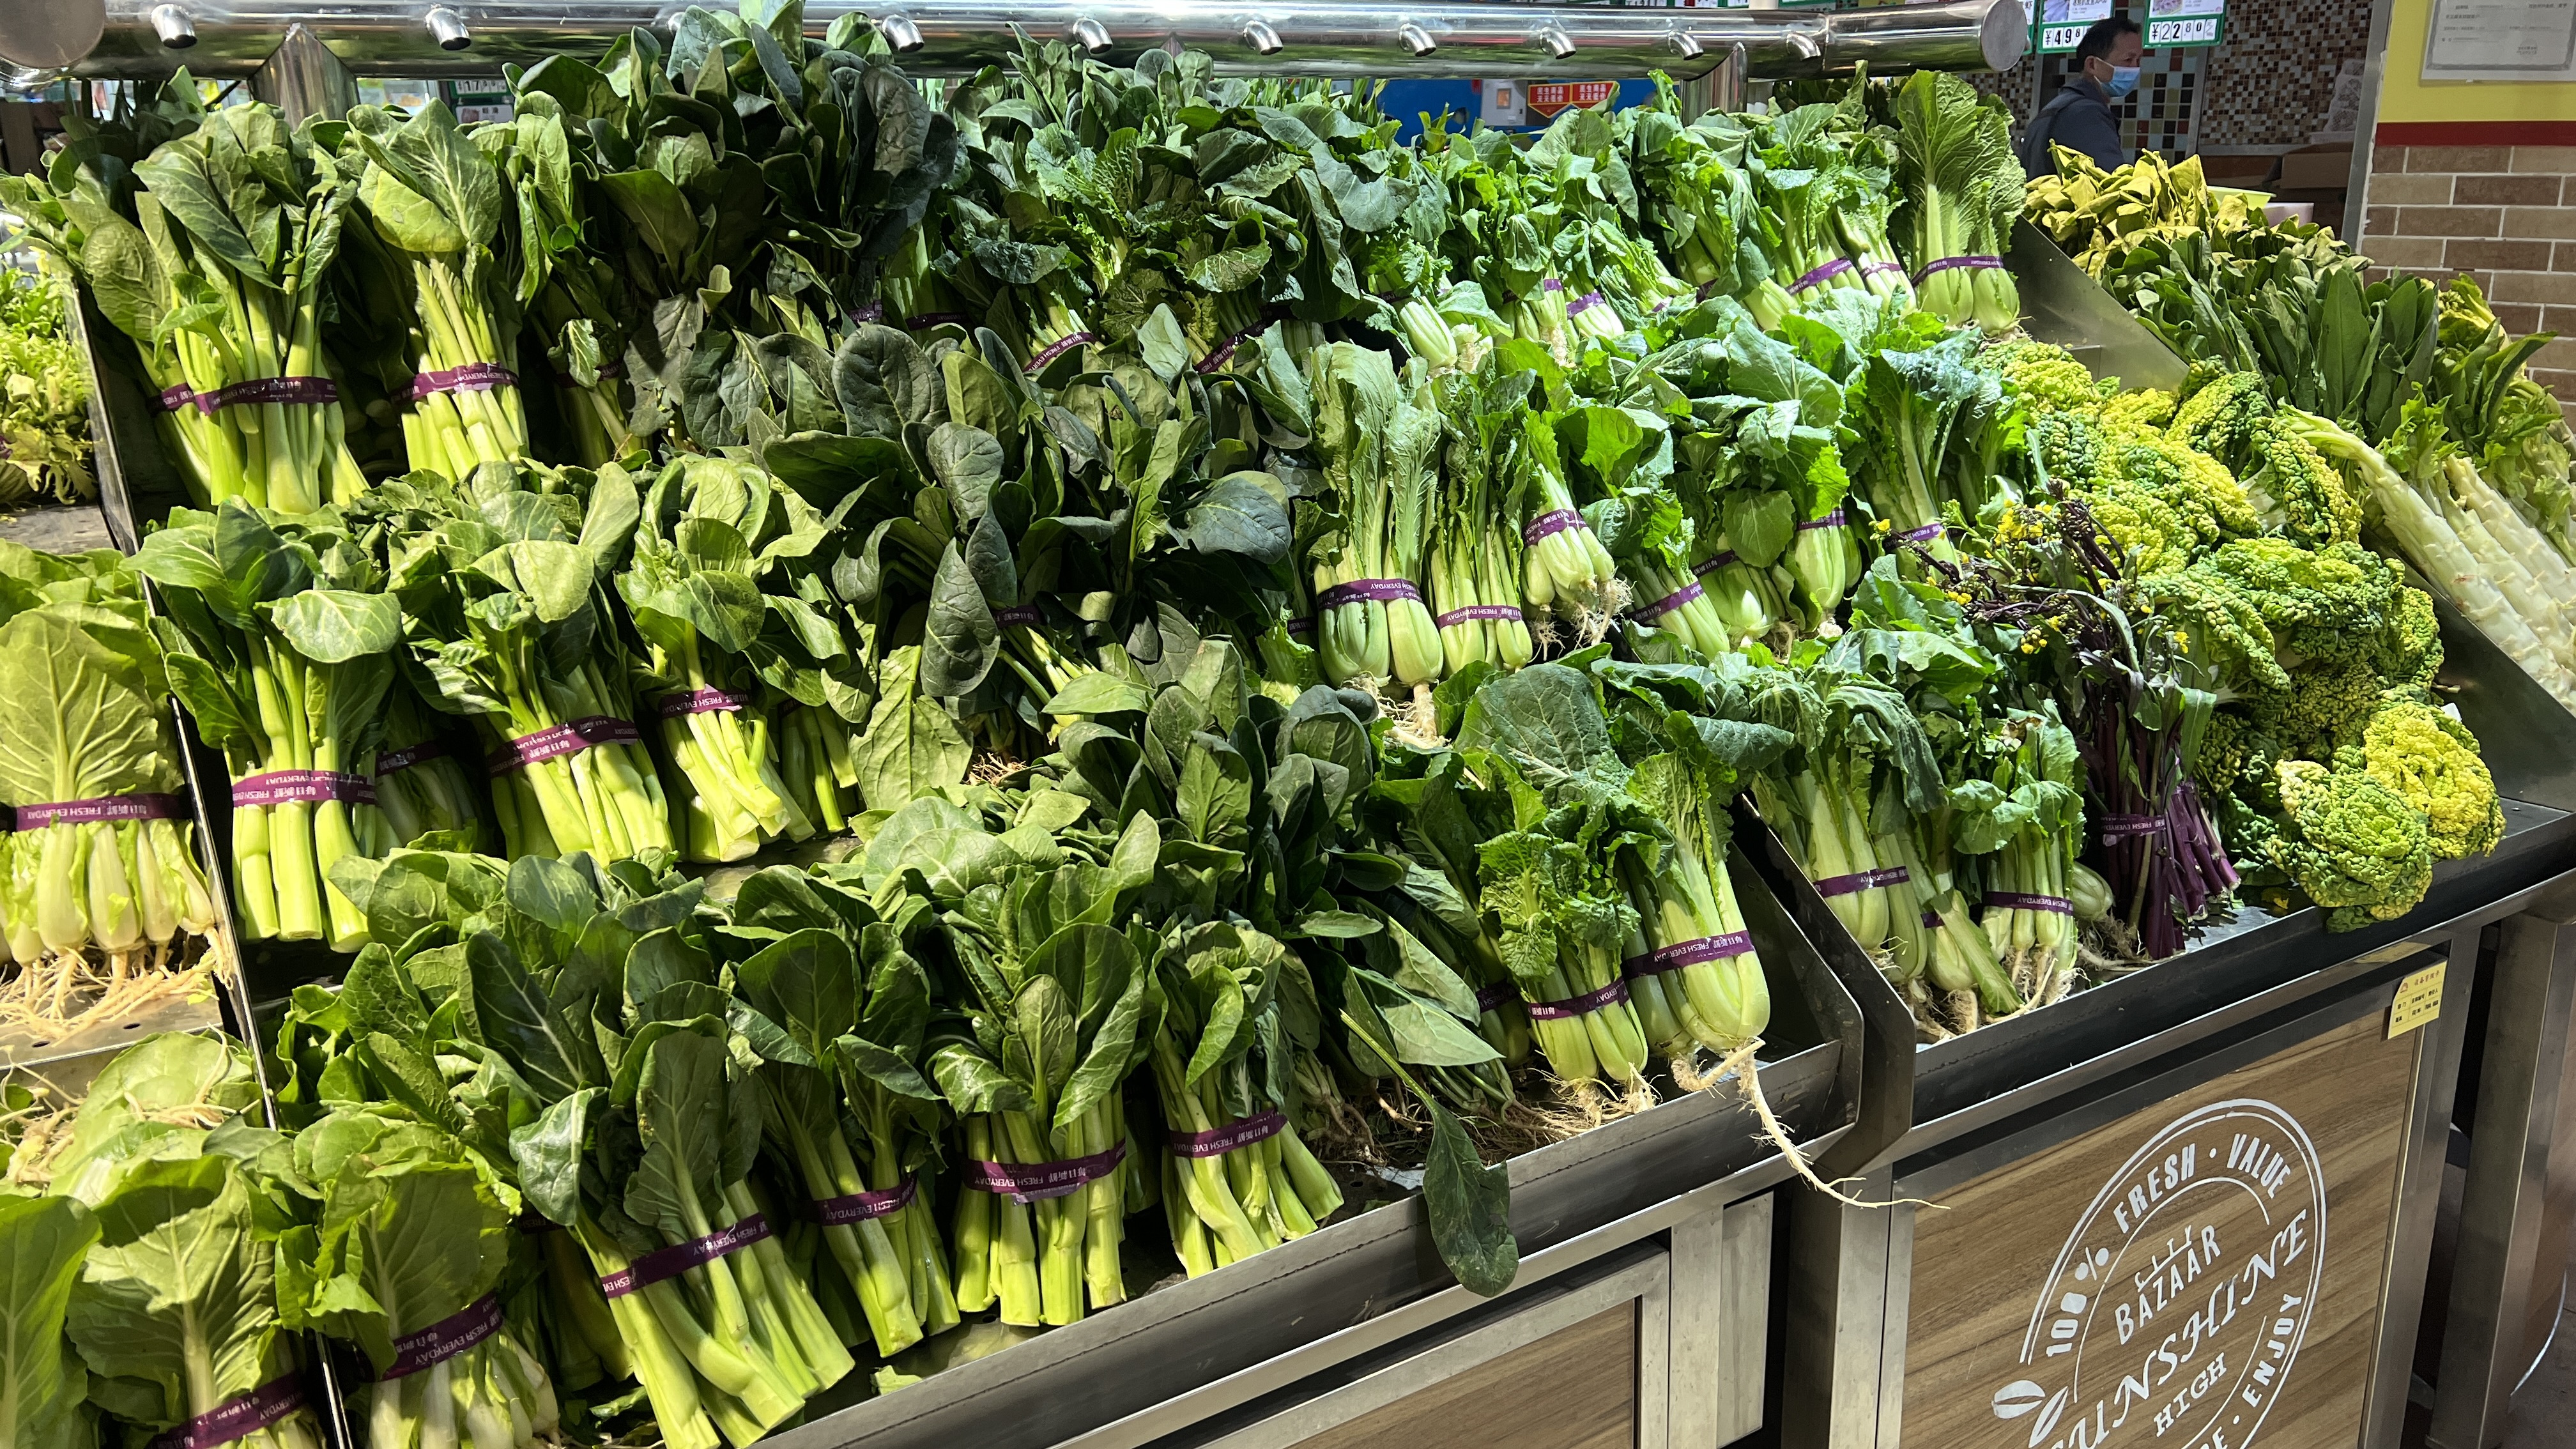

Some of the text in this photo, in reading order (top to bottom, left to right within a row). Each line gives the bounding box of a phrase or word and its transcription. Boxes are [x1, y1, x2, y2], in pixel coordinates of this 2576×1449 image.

[2046, 27, 2091, 45] ¥49.8
[2152, 21, 2202, 40] ¥22.80
[698, 696, 723, 707] FRESH
[244, 790, 270, 799] FRESH
[273, 786, 316, 799] 每日新鲜
[70, 807, 101, 816] FRESH
[2017, 896, 2051, 906] EVERYDAY
[1653, 946, 1687, 963] EVERYDAY
[1687, 942, 1710, 953] FRESH
[1237, 1124, 1268, 1143] 每日新鲜
[1209, 1137, 1233, 1149] FRESH
[974, 1167, 1086, 1187] 每日新鲜 FRESH EVERYDAY
[2113, 1142, 2196, 1234] FRESH
[2227, 1133, 2291, 1199] VALUE
[825, 1198, 900, 1220] FRESH EVERYDAY
[736, 1226, 756, 1239] FRESH
[2115, 1225, 2221, 1345] BAZAAR
[2051, 1209, 2306, 1449] UNSHINE
[415, 1322, 487, 1365] FRESH EVERYDAY
[2242, 1294, 2302, 1407] ENJOY
[2153, 1352, 2227, 1438] HIGH
